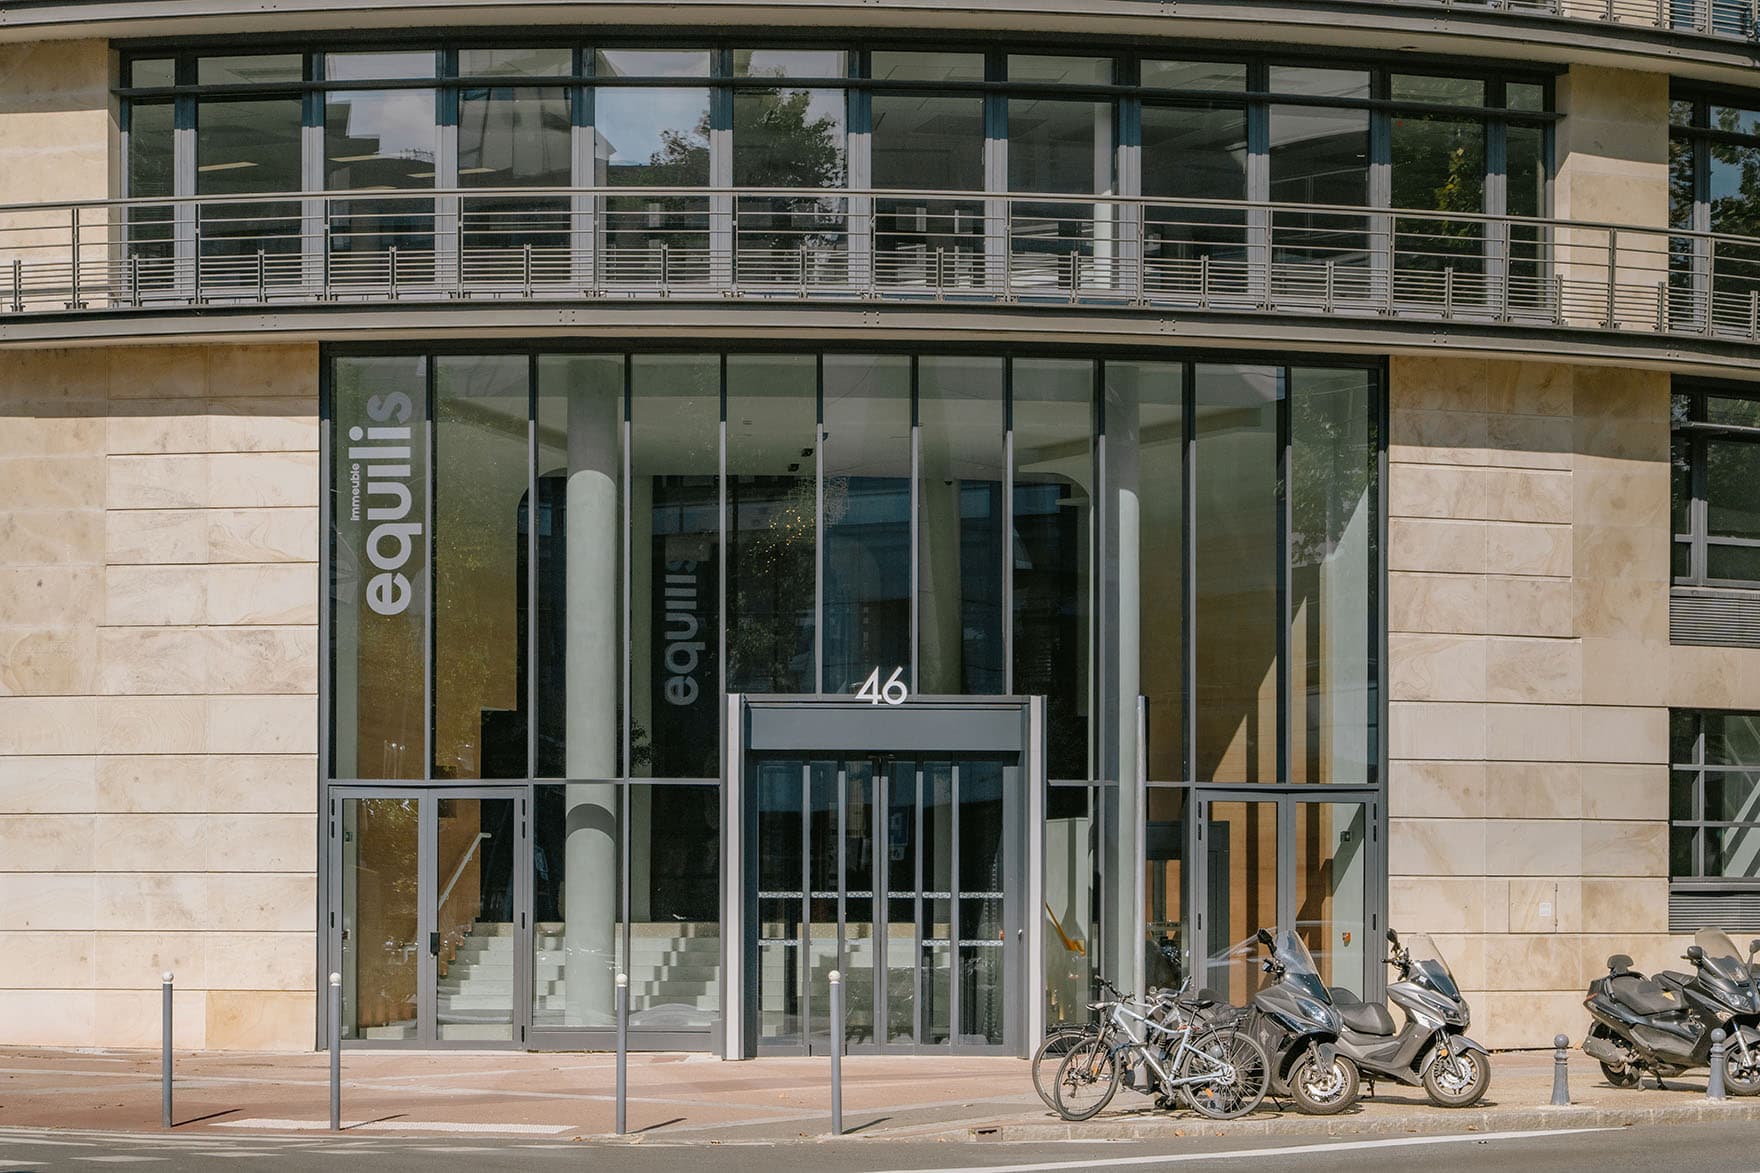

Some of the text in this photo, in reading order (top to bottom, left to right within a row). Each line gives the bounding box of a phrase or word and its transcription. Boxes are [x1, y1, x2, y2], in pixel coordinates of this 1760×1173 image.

[349, 391, 422, 616] equilis
[350, 463, 361, 521] immeuble
[855, 665, 908, 705] 46
